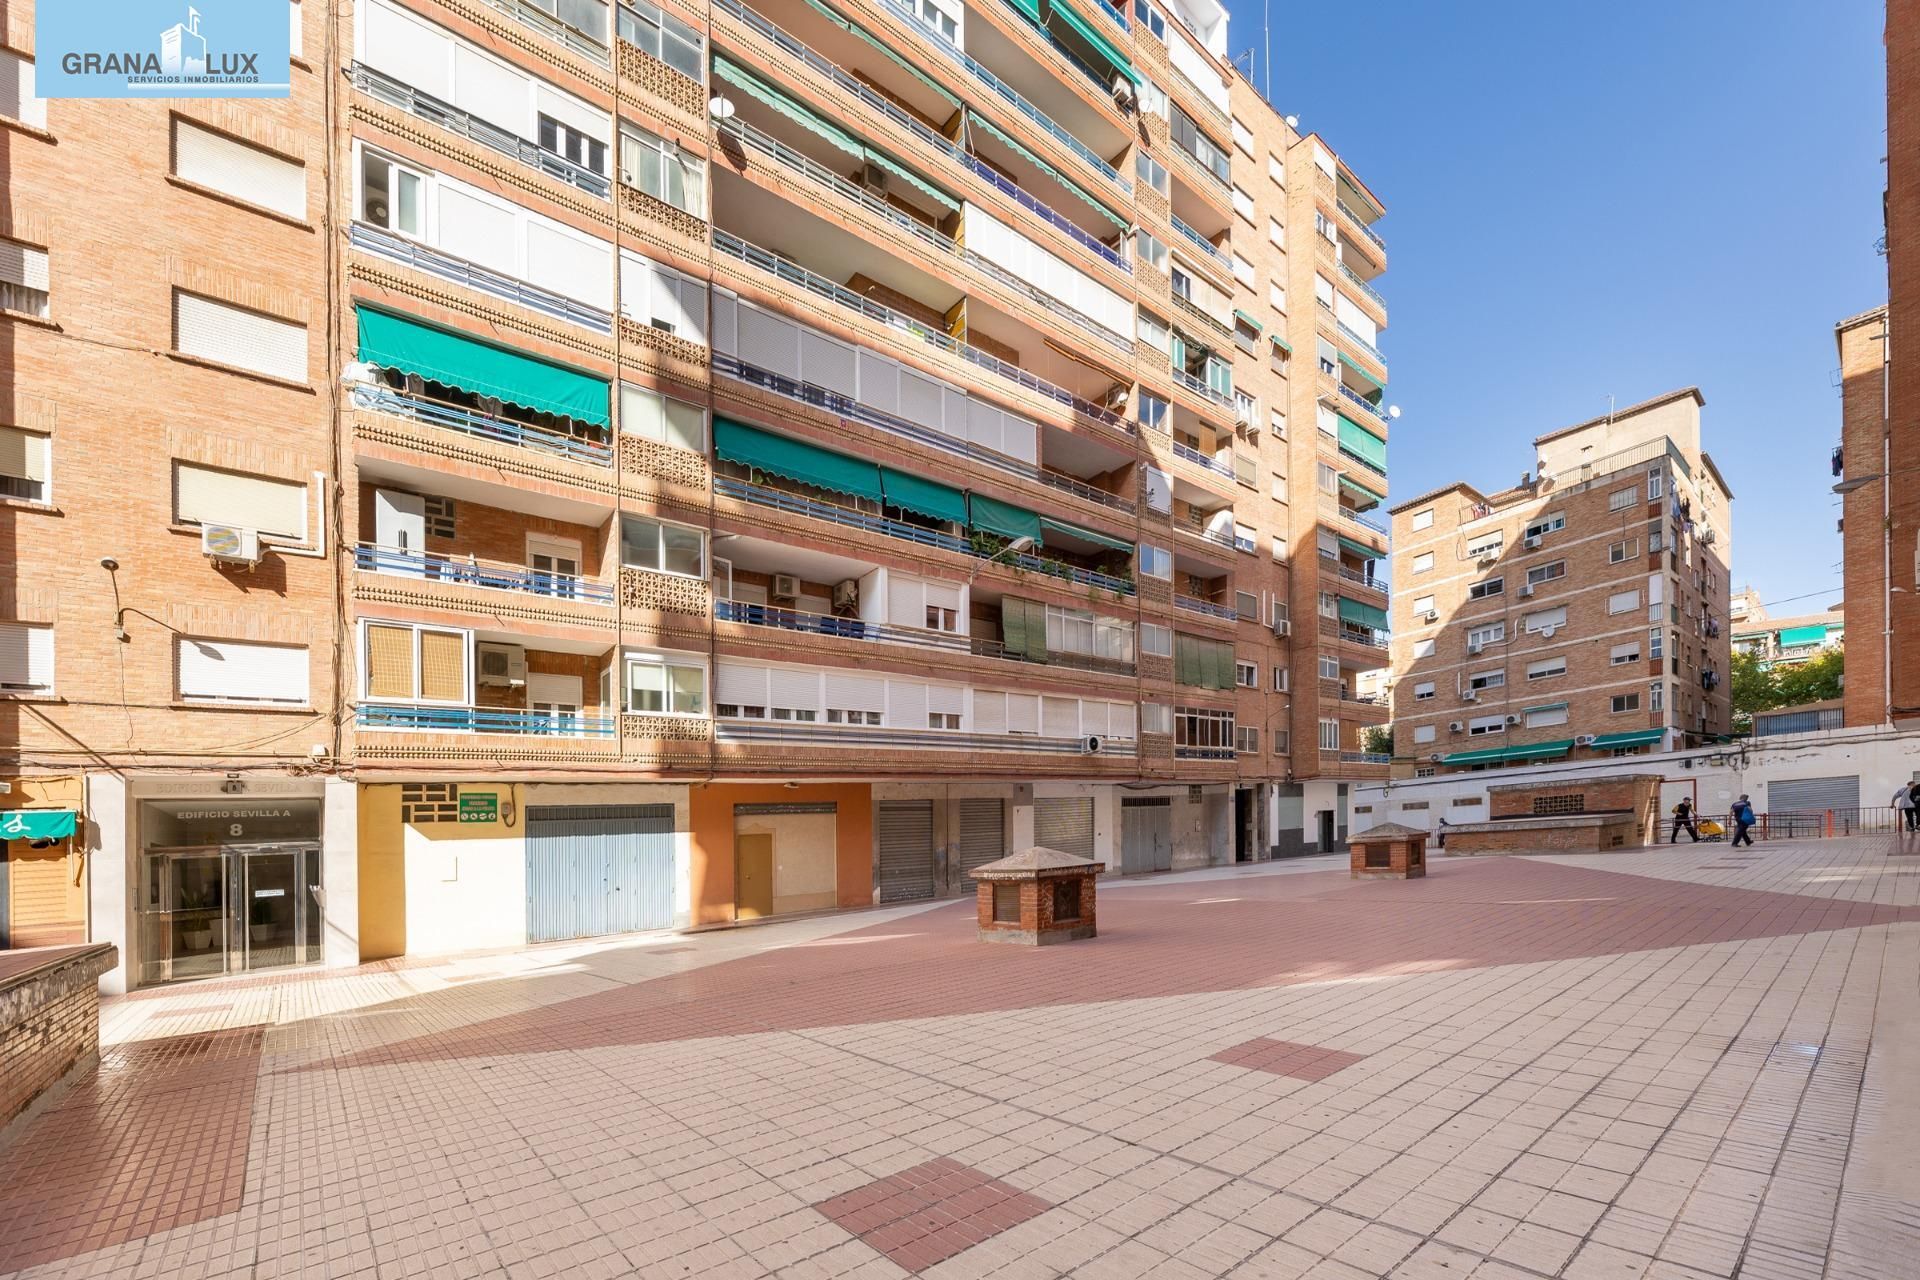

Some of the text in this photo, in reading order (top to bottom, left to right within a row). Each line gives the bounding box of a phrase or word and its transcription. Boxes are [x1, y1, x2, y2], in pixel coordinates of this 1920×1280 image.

[176, 809, 291, 820] EDIFICIO SEVILLA A
[229, 823, 243, 837] 8
